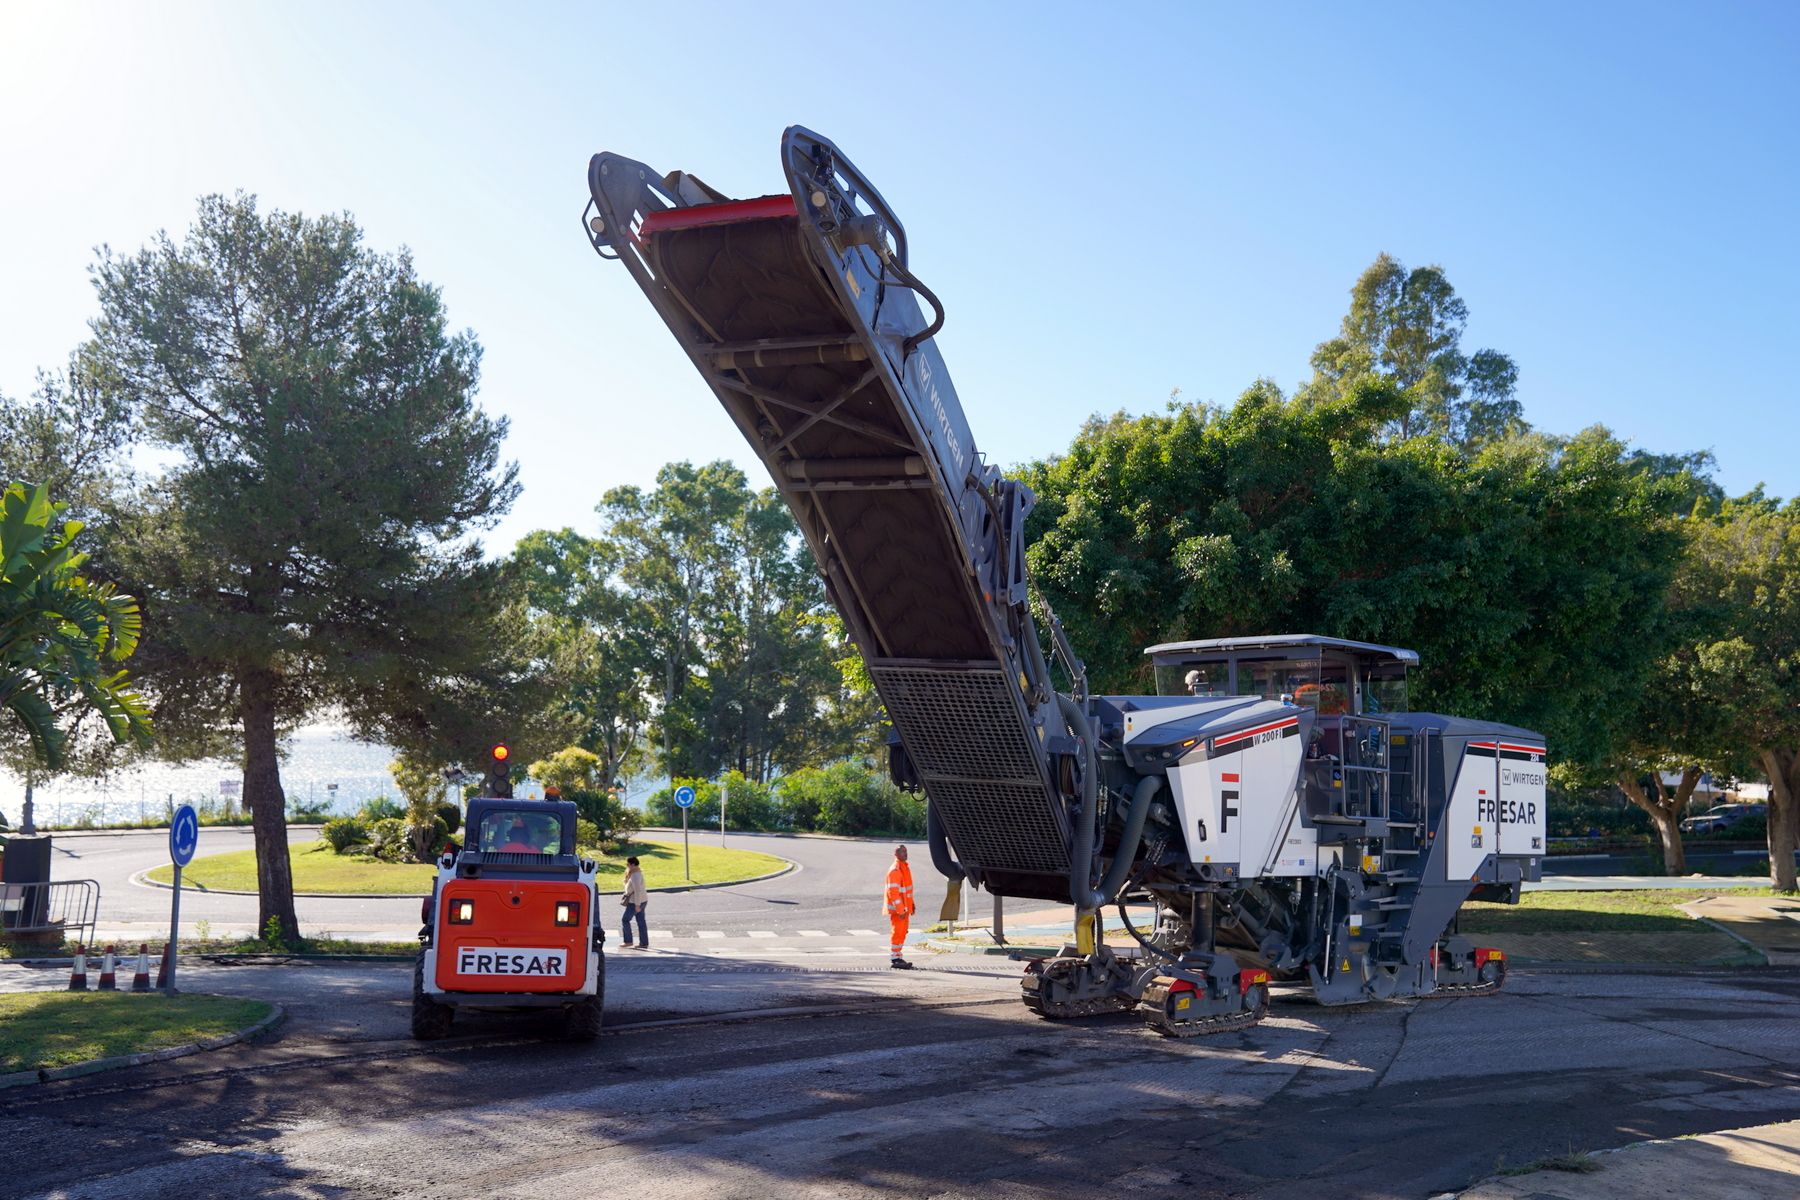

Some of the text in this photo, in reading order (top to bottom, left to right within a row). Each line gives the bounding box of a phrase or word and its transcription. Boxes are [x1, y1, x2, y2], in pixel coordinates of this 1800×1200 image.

[930, 384, 964, 468] WIRTGEN
[1254, 735, 1261, 745] W
[1512, 772, 1544, 786] WIRTGEN
[1221, 790, 1239, 833] F
[1478, 798, 1536, 825] FRESAR
[460, 954, 562, 975] FRESAR
